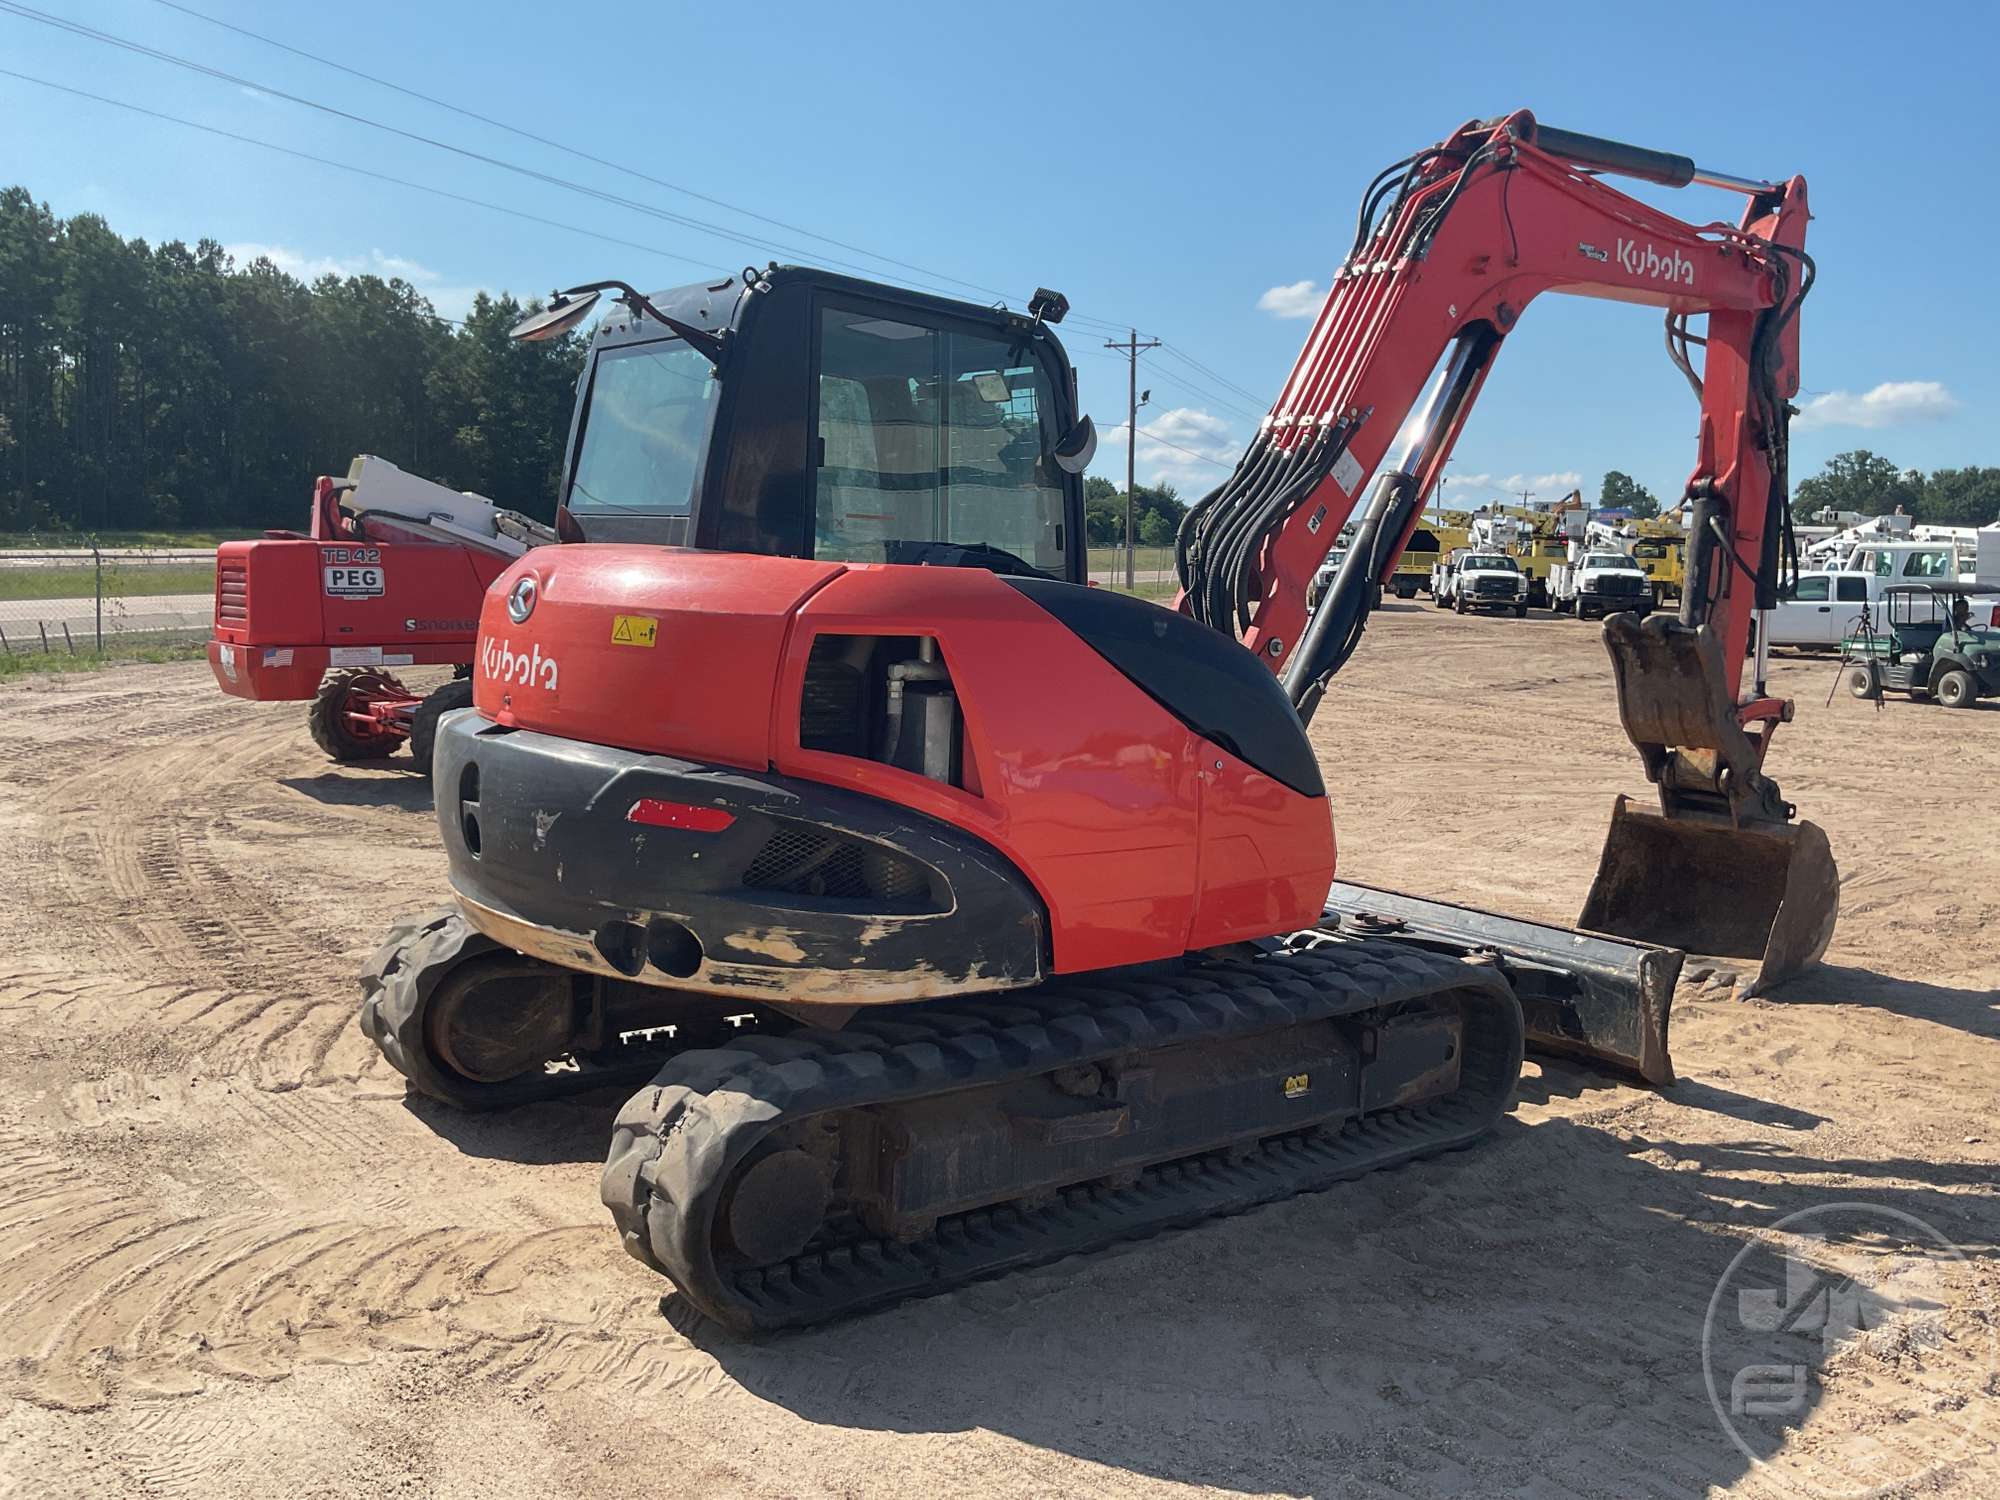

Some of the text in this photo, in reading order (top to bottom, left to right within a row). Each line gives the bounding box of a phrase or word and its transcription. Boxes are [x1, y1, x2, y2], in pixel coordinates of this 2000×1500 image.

[1616, 237, 1694, 285] Kubota
[332, 570, 377, 586] PEG
[482, 636, 558, 690] Kubota
